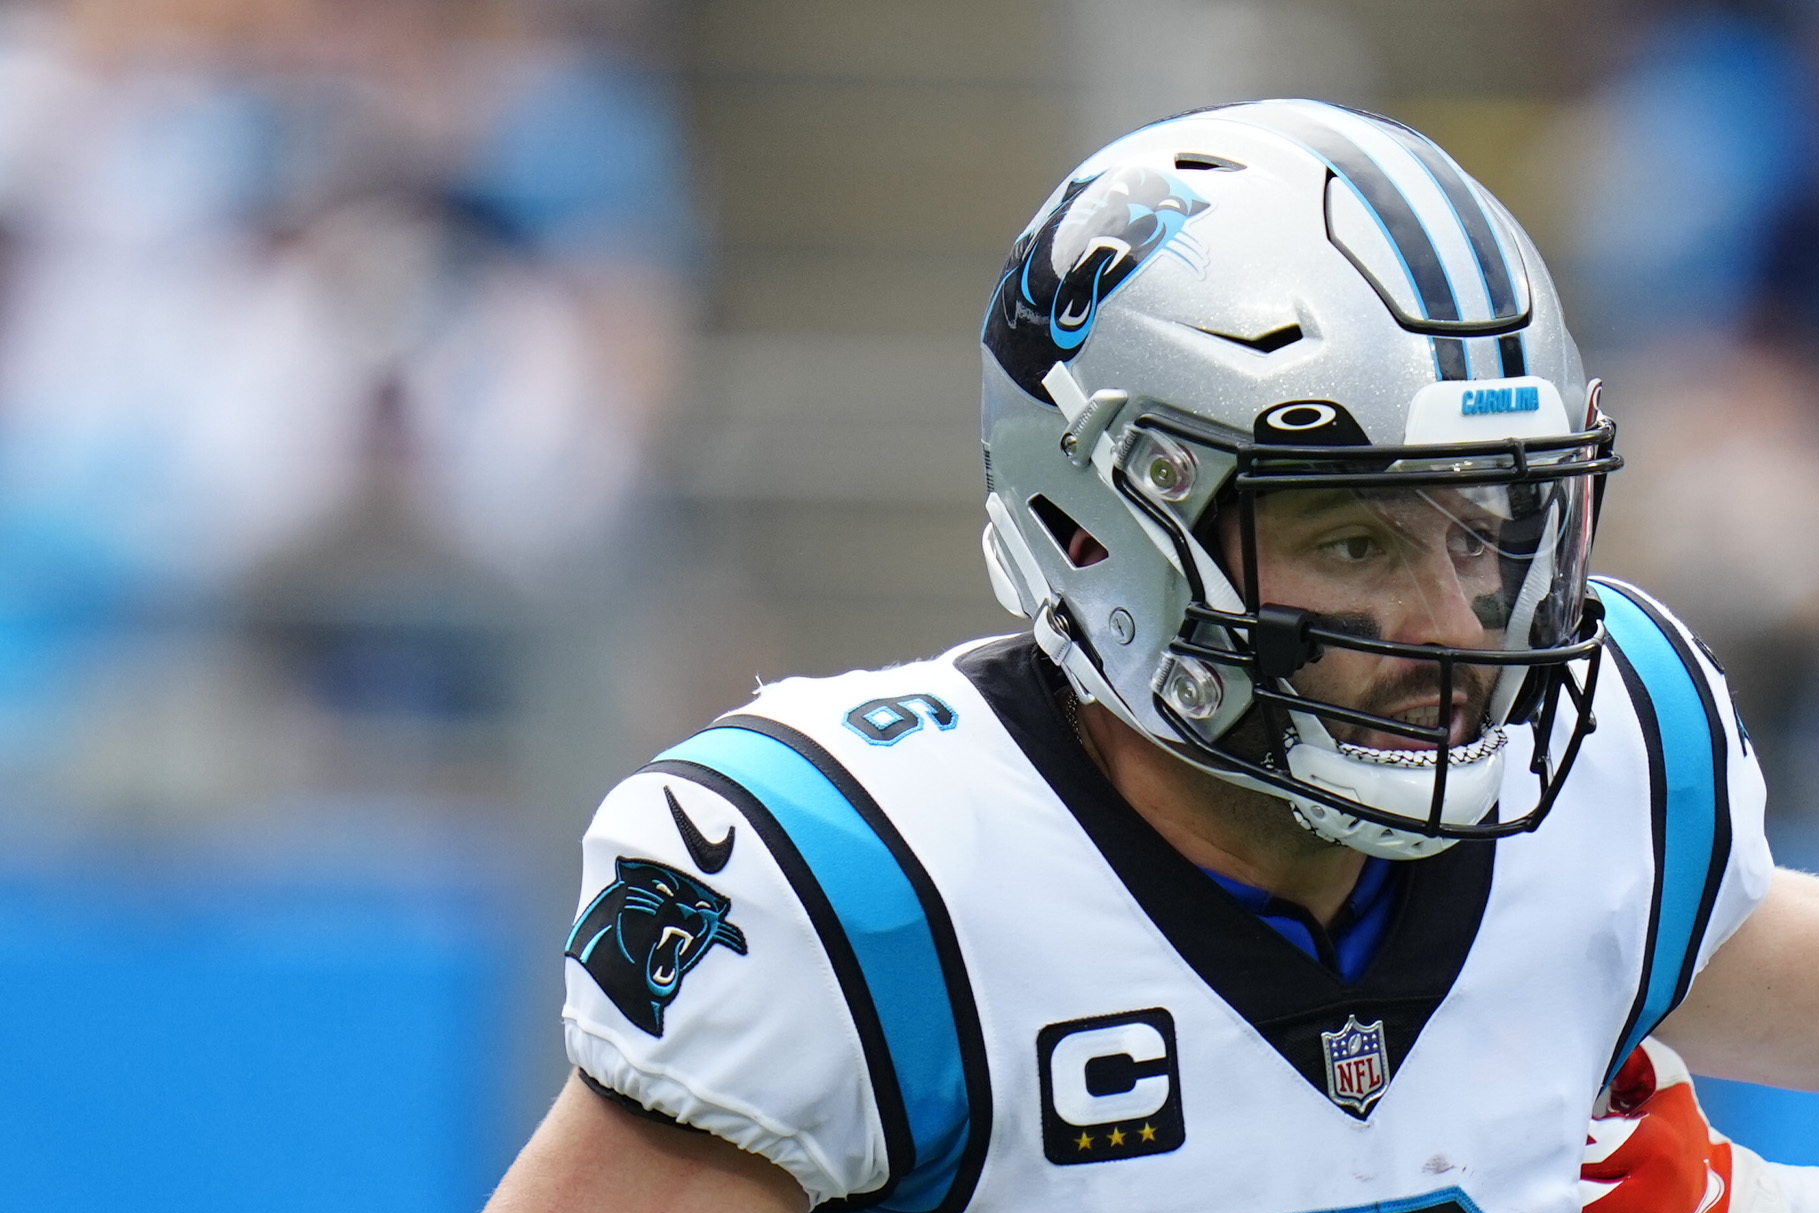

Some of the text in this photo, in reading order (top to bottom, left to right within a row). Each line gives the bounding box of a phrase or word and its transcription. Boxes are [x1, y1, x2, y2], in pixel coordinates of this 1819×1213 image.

[1462, 386, 1539, 415] CAROLINA
[841, 693, 959, 747] 6
[1050, 1022, 1170, 1127] C
[1336, 1057, 1381, 1095] NFL
